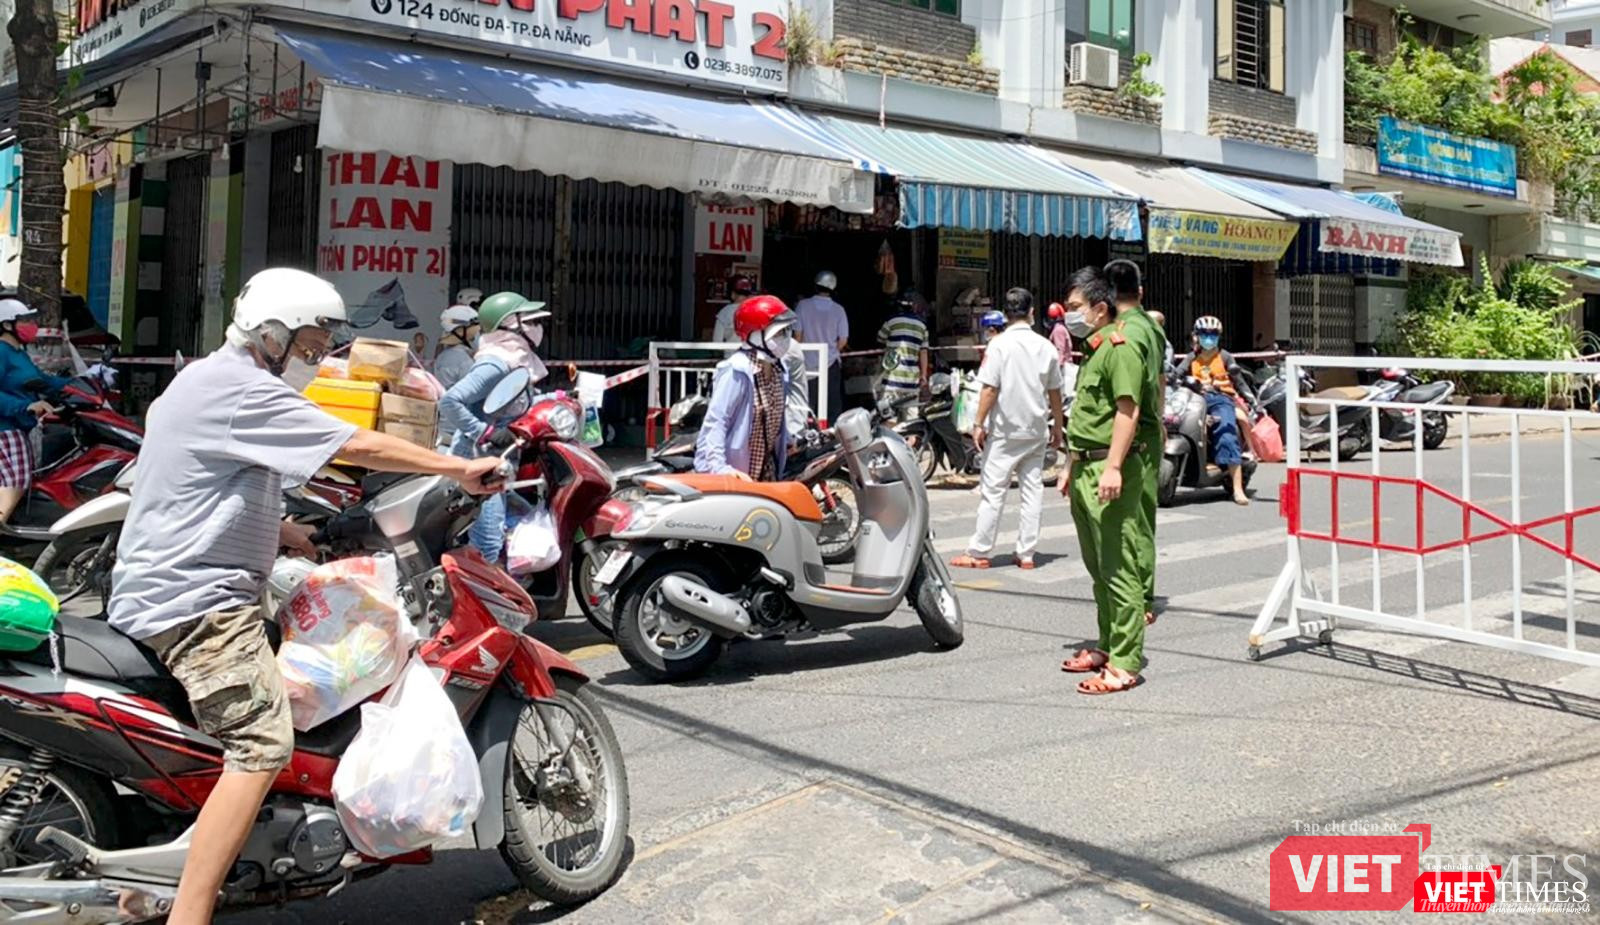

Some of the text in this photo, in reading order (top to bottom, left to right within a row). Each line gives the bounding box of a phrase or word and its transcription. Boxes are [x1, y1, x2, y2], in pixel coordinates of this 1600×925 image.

[440, 7, 480, 27] ĐỐNG
[752, 12, 787, 60] 2
[704, 59, 783, 82] 0236.3897.075
[330, 197, 432, 232] LAN
[708, 221, 753, 252] LAN
[352, 240, 418, 273] PHÁT
